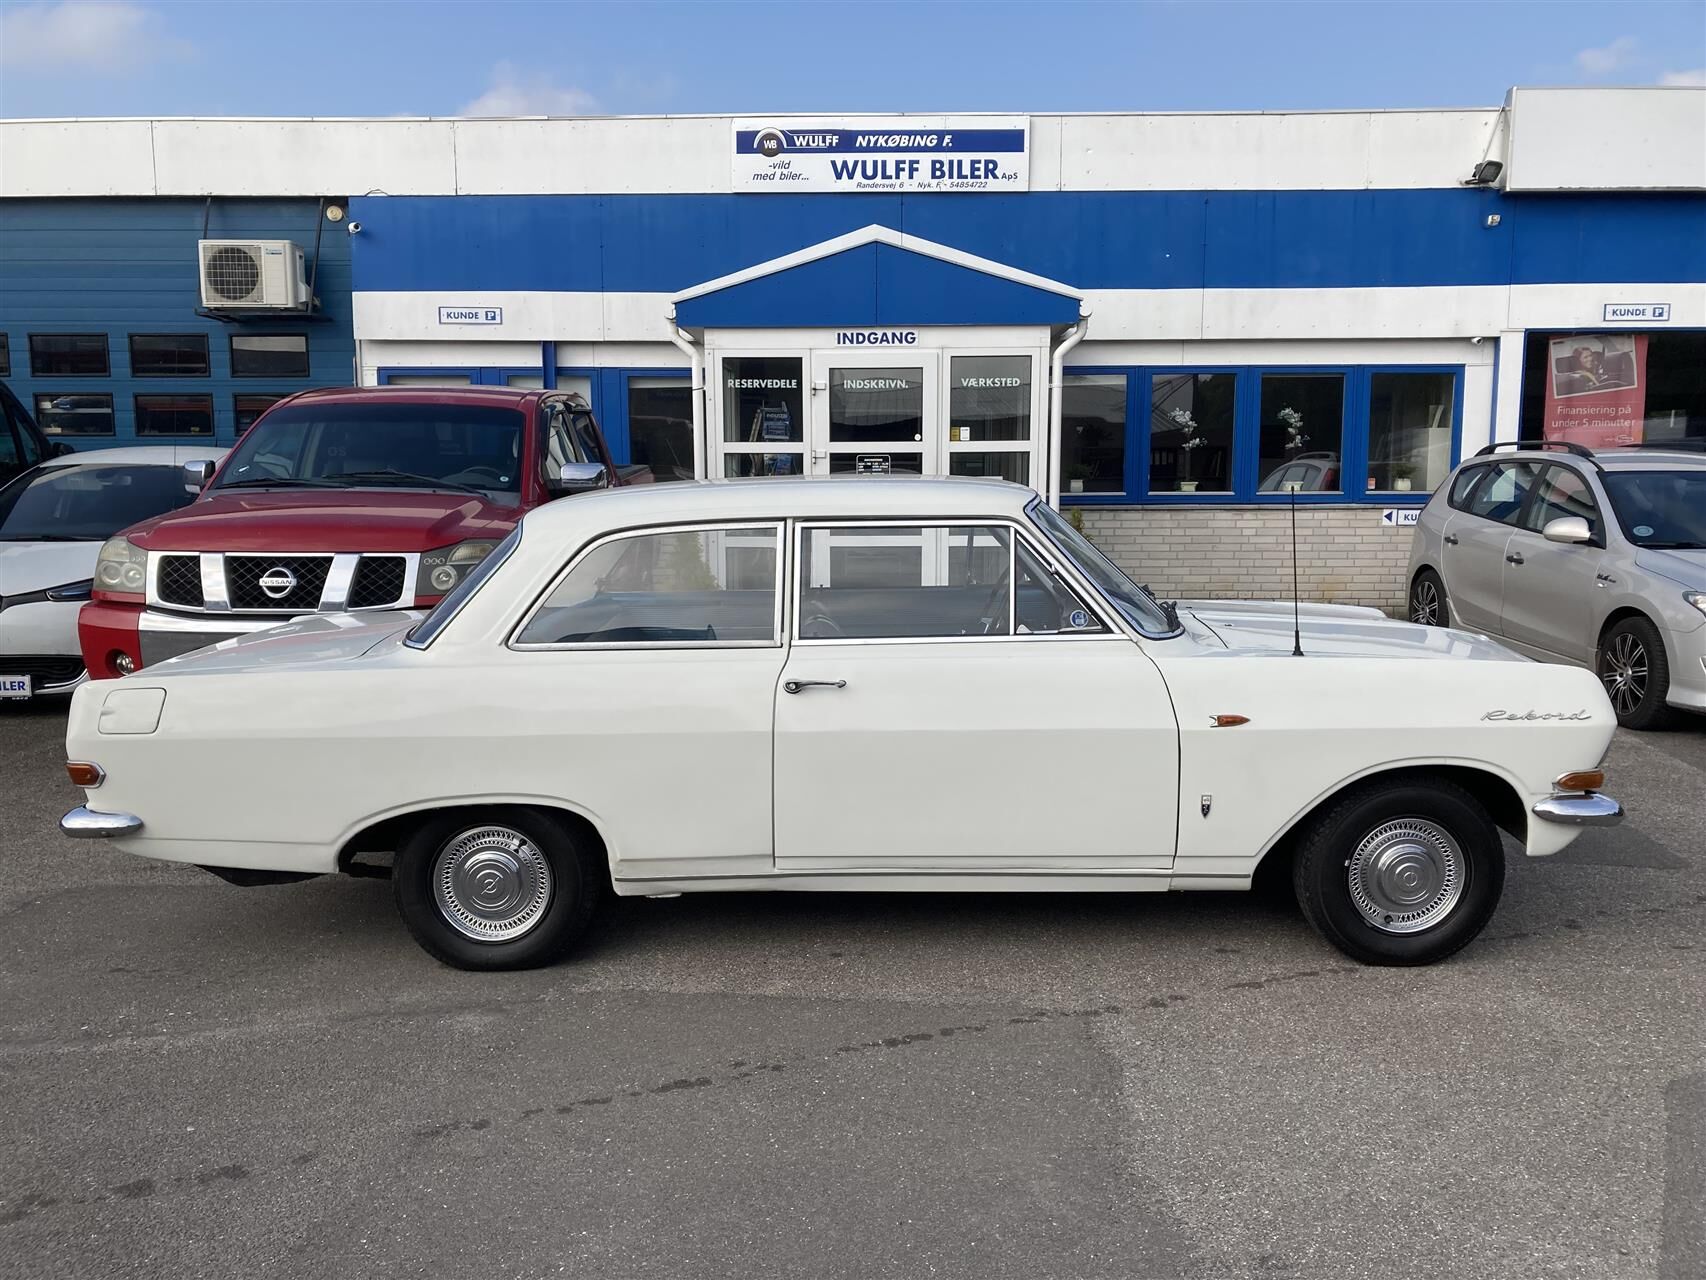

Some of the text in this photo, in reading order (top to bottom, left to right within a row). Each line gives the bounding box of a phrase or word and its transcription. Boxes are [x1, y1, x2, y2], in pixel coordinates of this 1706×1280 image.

[763, 139, 778, 149] WB
[793, 135, 839, 147] WULFF
[855, 134, 953, 147] NYKØBING F.
[768, 160, 792, 170] -vild
[829, 159, 1019, 181] WULFF BILER ApS
[752, 171, 809, 181] med biler...
[856, 181, 897, 190] Randersvej
[898, 181, 905, 189] 6
[917, 181, 934, 190] Nyk.
[949, 181, 988, 189] 54854722
[446, 311, 480, 320] KUNDE
[1611, 308, 1647, 317] KUNDE
[836, 331, 917, 345] INDGANG
[727, 379, 798, 389] RESERVEDELE
[843, 379, 909, 389] INDSKRIVN.
[960, 377, 1021, 387] VÆRKSTED
[1557, 404, 1632, 416] Finansiering på
[1551, 418, 1635, 428] under 5 minutter
[1403, 513, 1418, 522] KU
[1480, 708, 1592, 721] Rekord
